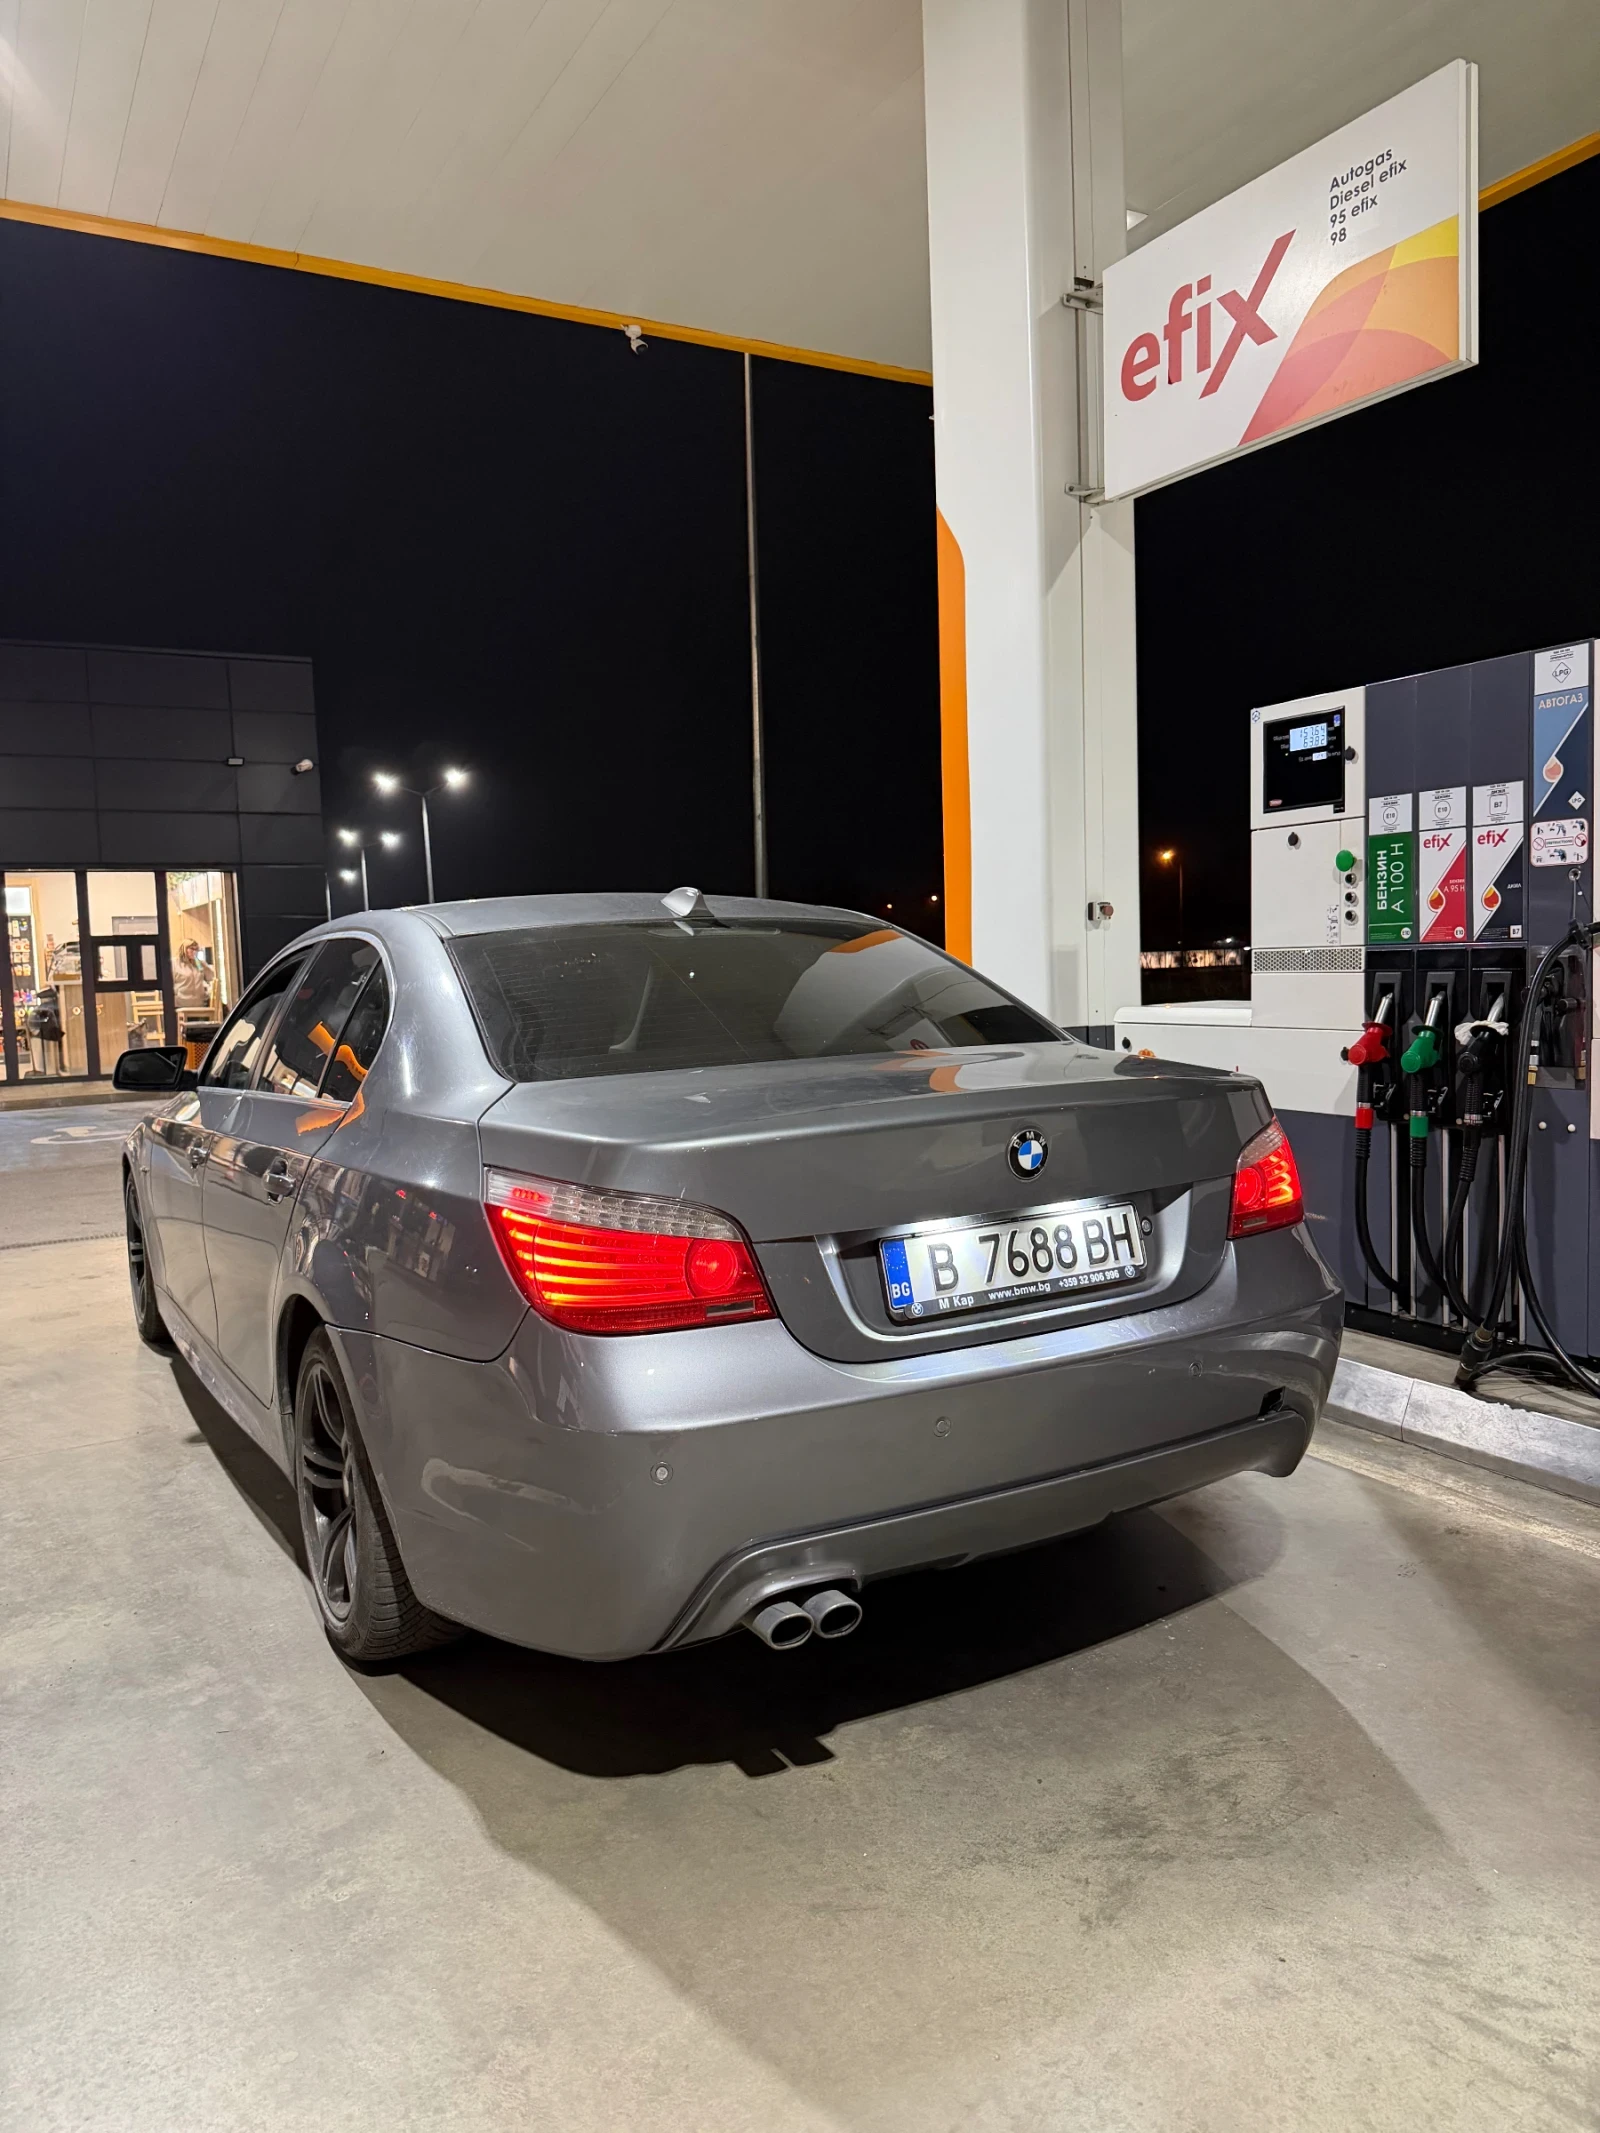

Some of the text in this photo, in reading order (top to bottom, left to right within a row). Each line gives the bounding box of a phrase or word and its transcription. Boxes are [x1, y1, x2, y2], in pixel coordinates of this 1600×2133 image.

[1329, 148, 1393, 193] Autogas
[1329, 159, 1408, 211] Diesel efix
[1329, 194, 1378, 229] 95 efix
[1329, 226, 1347, 246] 98
[1120, 228, 1297, 402] efix
[1554, 668, 1569, 677] LPG
[1538, 692, 1584, 710] АВТОГАЗ
[1437, 806, 1448, 814] E10
[1423, 832, 1453, 852] efix
[1477, 828, 1509, 848] efix
[1376, 849, 1388, 911] БЕНЗИН
[1390, 861, 1405, 893] 100
[1450, 884, 1459, 893] 95
[1512, 928, 1521, 936] B7
[1013, 1131, 1047, 1149] BMW
[928, 1212, 1136, 1293] B 7688 BH
[1058, 1269, 1120, 1288] +359 32 906 996
[891, 1282, 911, 1299] BG
[988, 1282, 1051, 1301] www.bmw.bg
